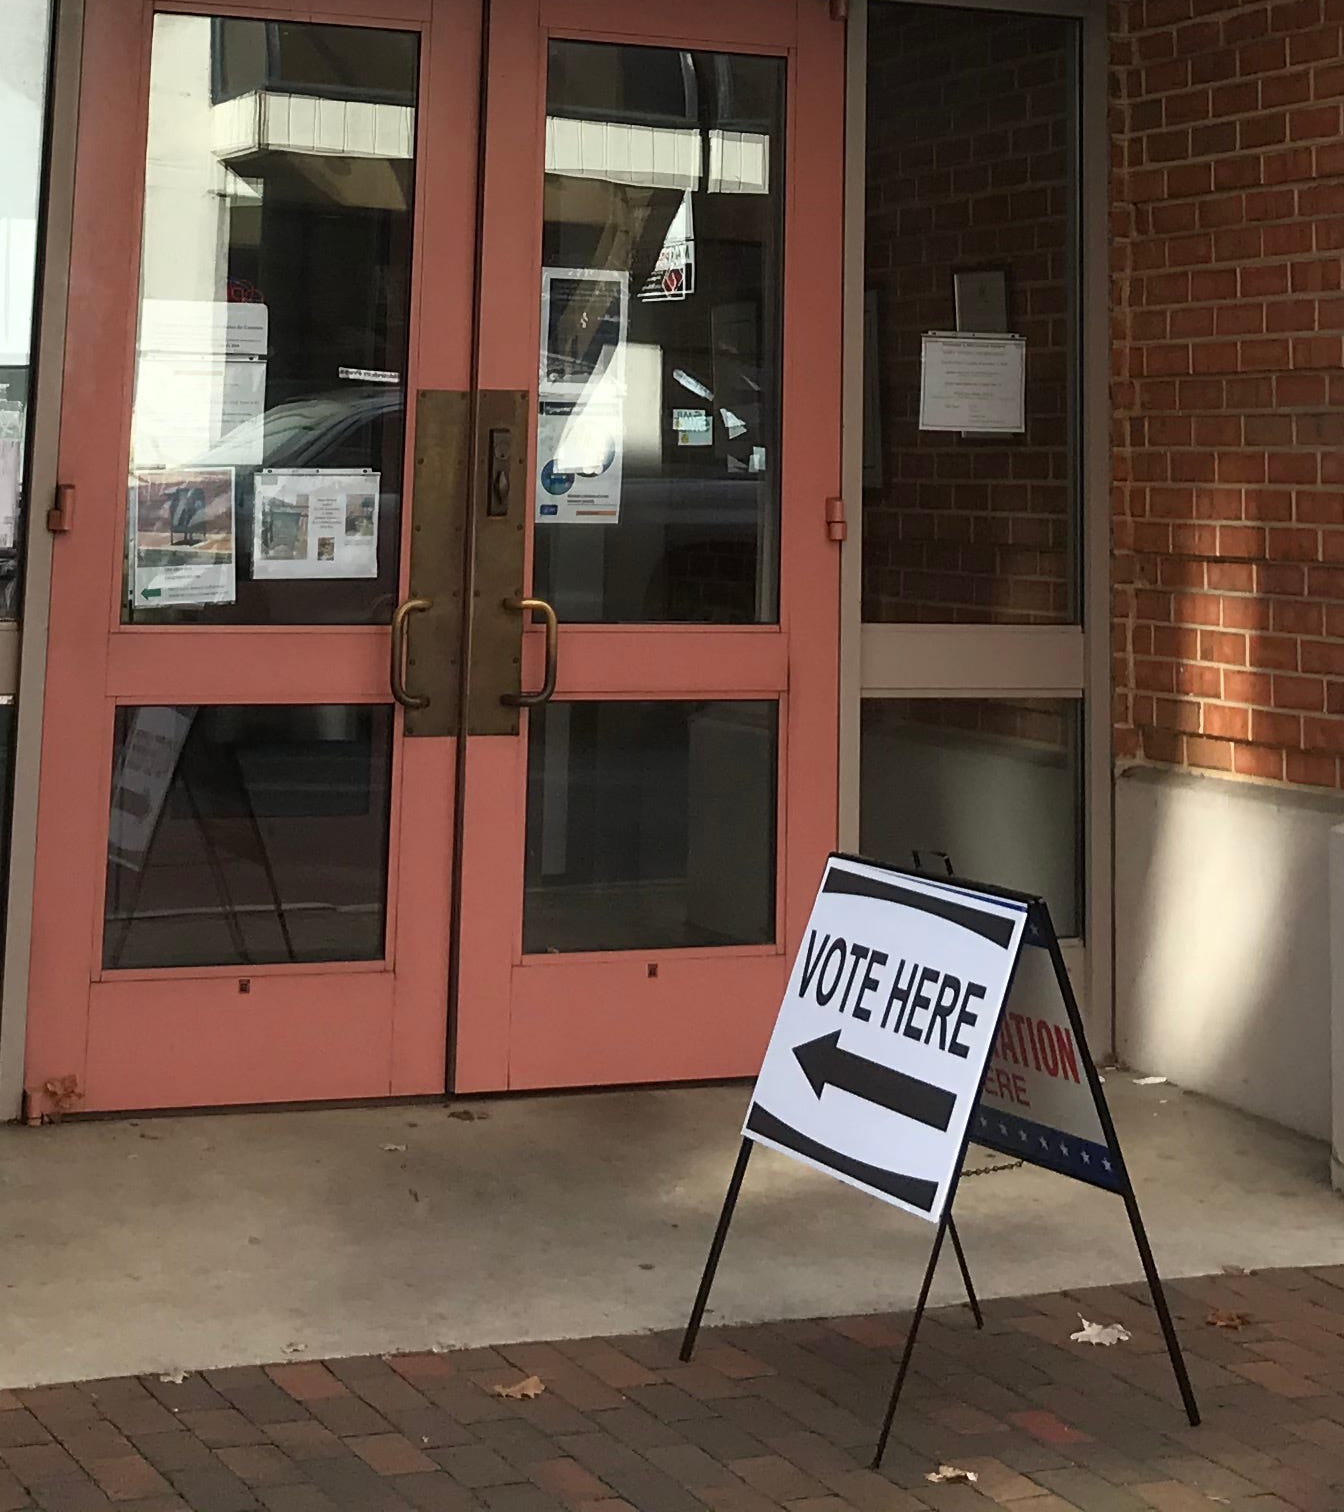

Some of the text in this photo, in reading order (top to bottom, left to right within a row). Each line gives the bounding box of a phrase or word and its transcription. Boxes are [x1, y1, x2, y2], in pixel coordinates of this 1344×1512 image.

[798, 929, 988, 1059] VOTE HERE
[994, 1012, 1080, 1084] ATION
